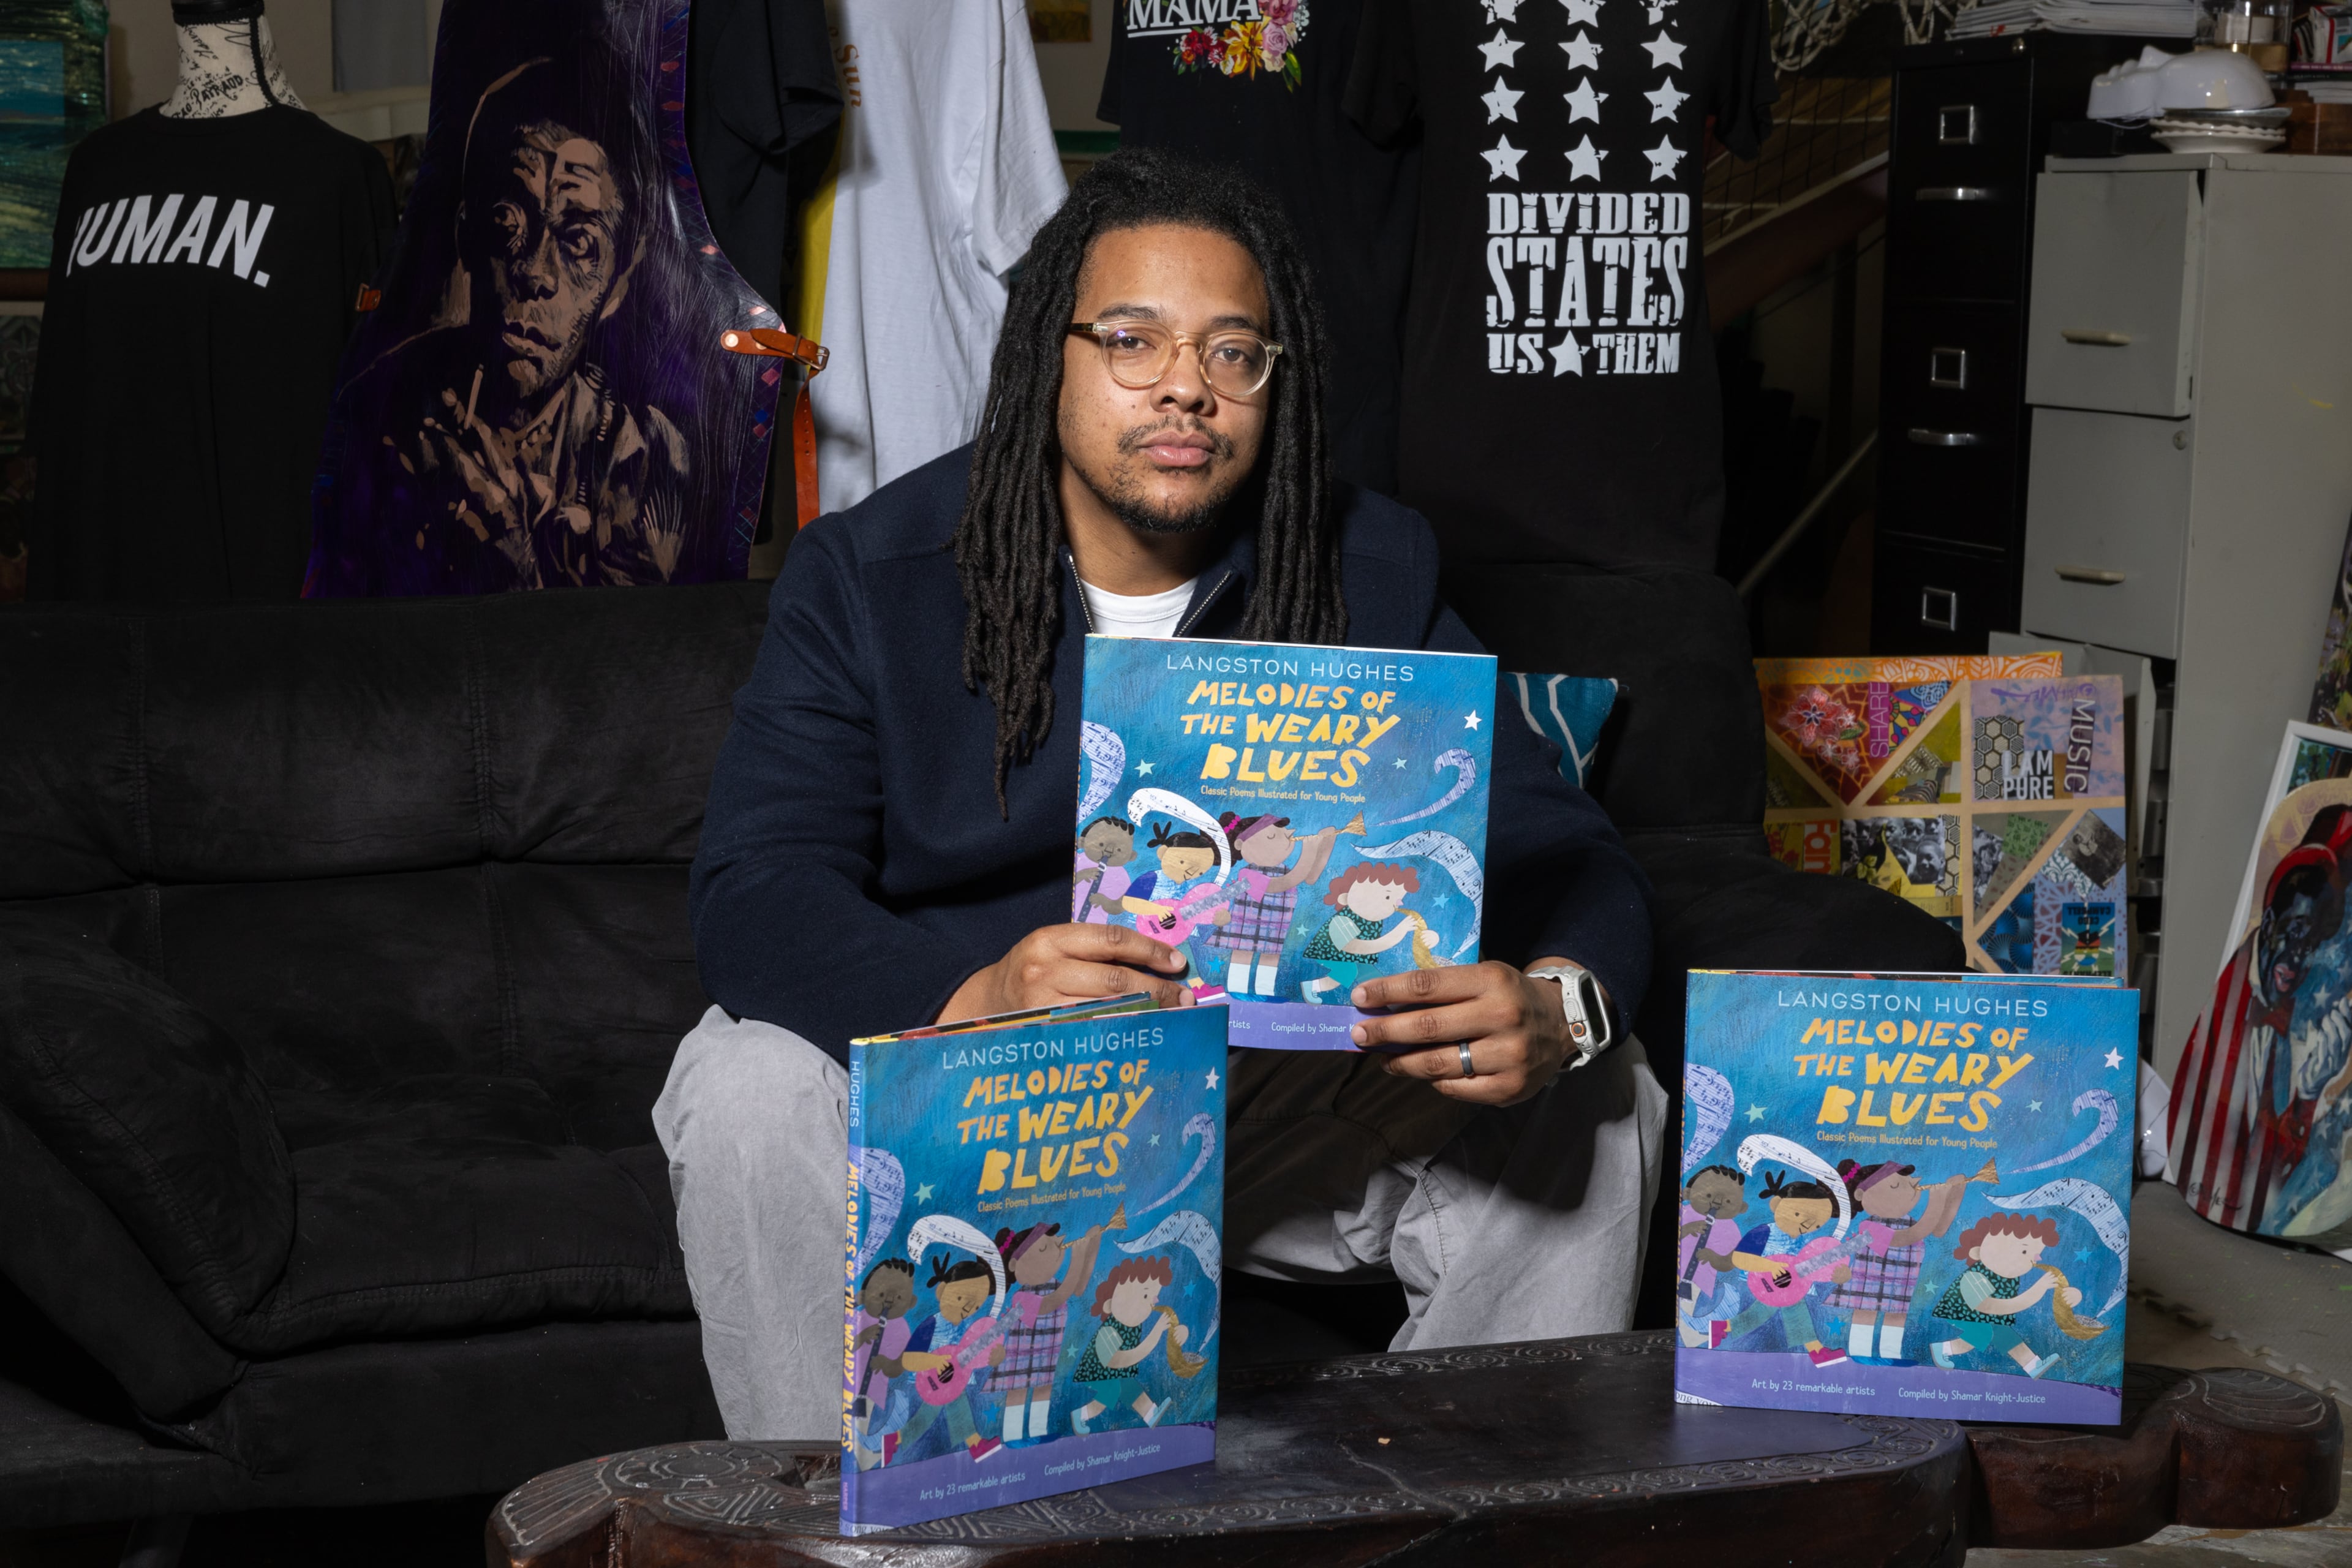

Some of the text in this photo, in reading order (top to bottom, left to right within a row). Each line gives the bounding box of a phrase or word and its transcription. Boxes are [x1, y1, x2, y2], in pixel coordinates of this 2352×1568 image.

[1126, 0, 1262, 29] MAMA
[834, 44, 862, 108] Sun
[1487, 192, 1690, 234] DIVIDED
[1486, 236, 1688, 327] STATES
[1487, 333, 1681, 374] US THEM
[1167, 654, 1414, 682] LANGSTON HUGHES
[1188, 681, 1395, 712] MELODIES OF
[1182, 714, 1399, 748] THE WEARY
[1870, 682, 1889, 758] SHARE
[2064, 698, 2095, 792] MUSIC
[1201, 744, 1370, 786] BLUES
[2002, 750, 2053, 776] I AM
[1200, 784, 1366, 805] Classic Poems Illustrated for Young People
[2003, 776, 2054, 800] PURE
[1779, 990, 2047, 1017] LANGSTON HUGHES
[1227, 1019, 1251, 1030] rtists
[1272, 1020, 1305, 1034] Compiled
[1308, 1023, 1317, 1035] by
[1319, 1023, 1347, 1034] Shamar
[1802, 1019, 2027, 1050] MELODIES OF
[943, 1028, 1164, 1069] LANGSTON HUGHES
[963, 1060, 1148, 1106] MELODIES OF
[1795, 1054, 2032, 1090] THE WEARY
[850, 1061, 860, 1128] HUGHES
[1817, 1086, 2000, 1131] BLUES
[958, 1087, 1153, 1143] THE WEARY
[1817, 1130, 1997, 1150] Classic Poems Illustrated for Young People
[977, 1133, 1128, 1194] BLUES
[976, 1181, 1125, 1213] Classic Poems Illustrated for Young People
[841, 1161, 859, 1452] MELODIES OF THE WEARY BLUES
[1752, 1379, 1875, 1395] Art by 23 remarkable artists
[1899, 1387, 2045, 1404] Compiled by Shamar Knight-Justice
[1044, 1443, 1161, 1476] Compiled by Shamar Knight-Justice
[920, 1472, 1025, 1501] Art by 23 remarkable artists
